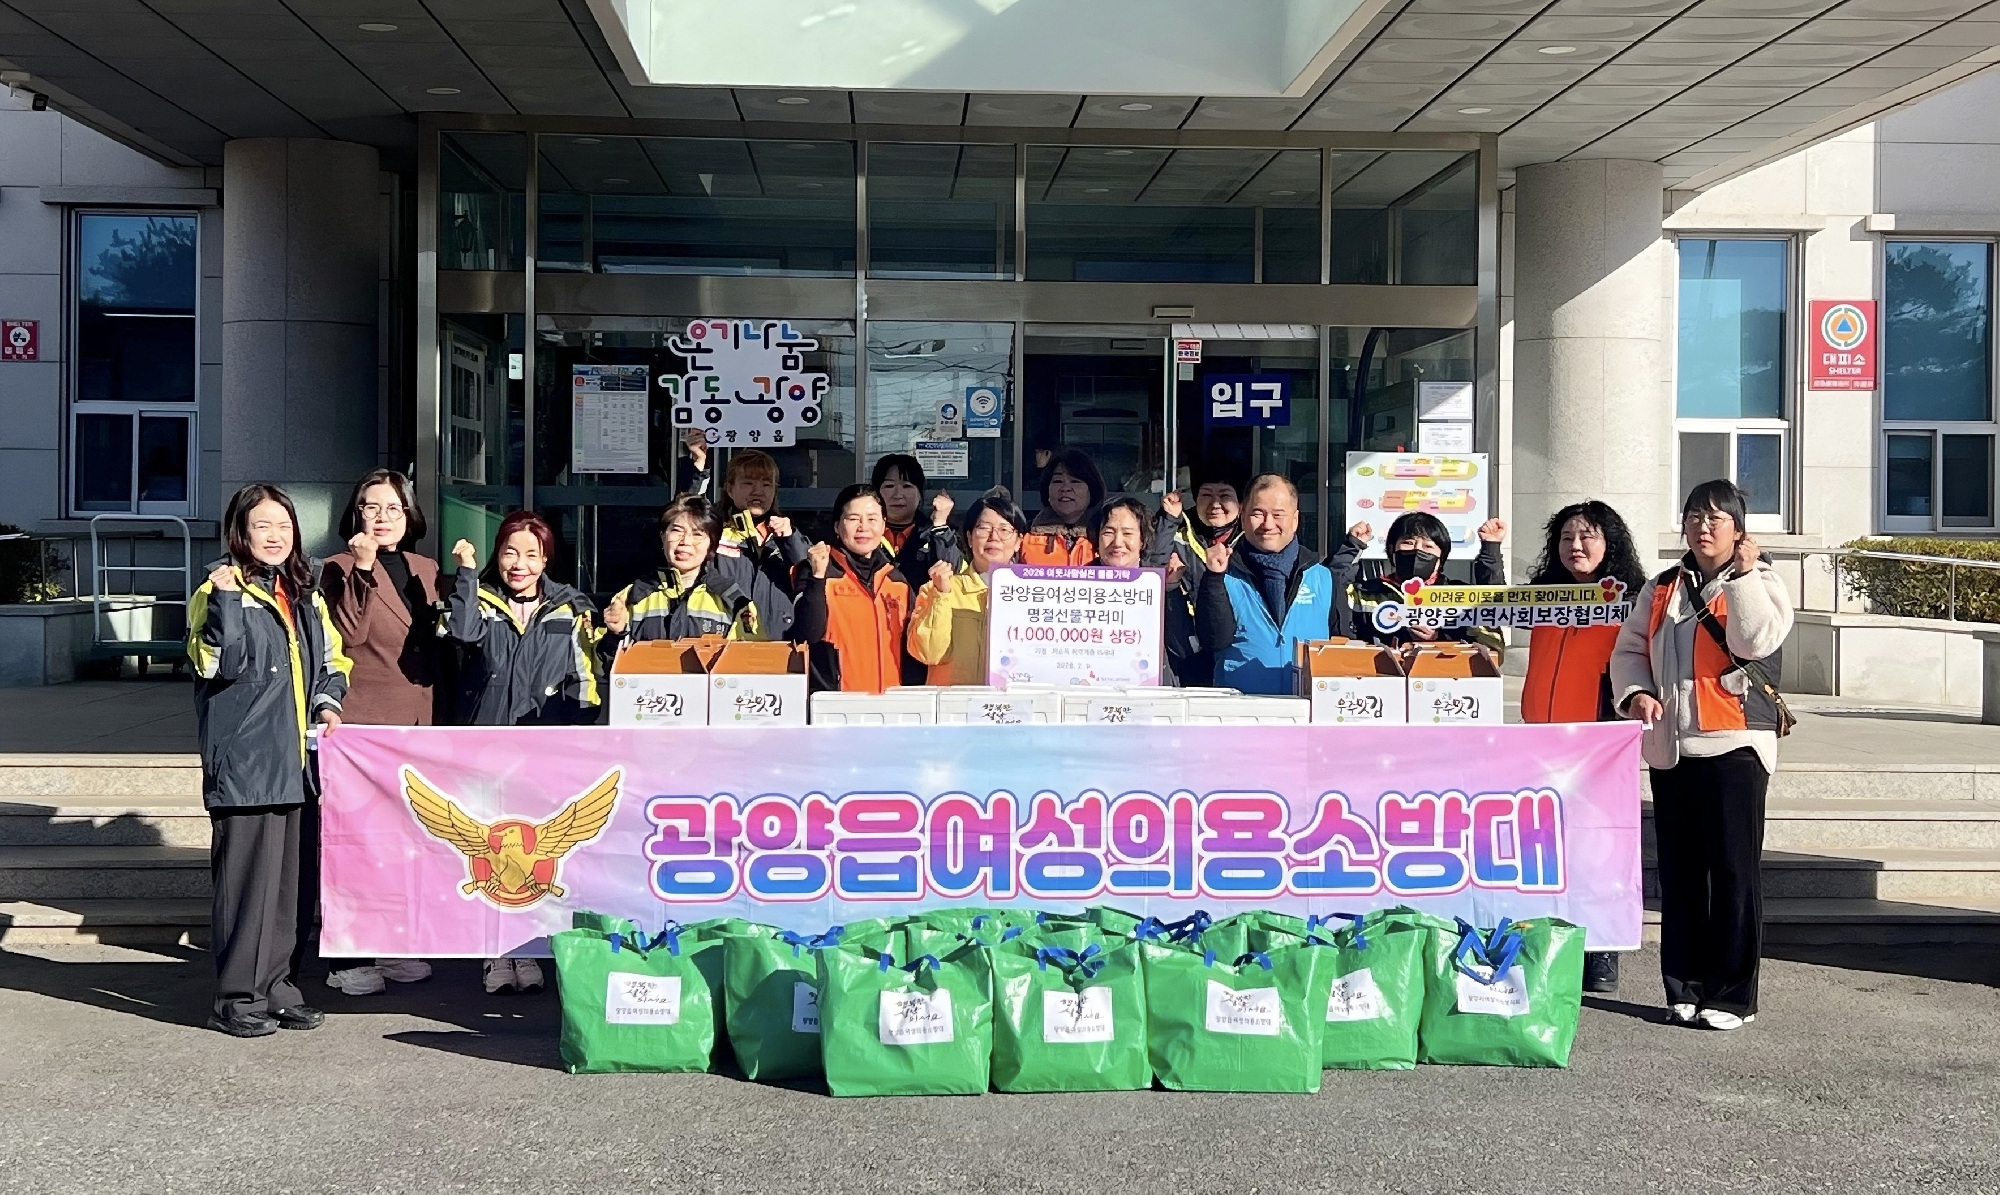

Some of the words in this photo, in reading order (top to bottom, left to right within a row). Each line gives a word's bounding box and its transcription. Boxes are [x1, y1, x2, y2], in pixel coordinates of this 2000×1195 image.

[671, 323, 816, 371] 온기나눔
[1823, 353, 1866, 365] 대피소
[1828, 367, 1862, 375] SHELTER
[1211, 382, 1283, 418] 입구
[1022, 568, 1045, 577] 2026
[1000, 585, 1153, 606] 광양읍여성의용소방대
[1430, 591, 1464, 604] 어려운
[1468, 590, 1504, 603] 이웃을
[1508, 590, 1531, 603] 먼저
[1534, 589, 1598, 603] 찾아갑니다.
[1027, 608, 1124, 625] 명절선물꾸러미
[1406, 604, 1629, 627] 광양읍지역사회보장협의체
[1007, 626, 1104, 644] (1,000,000원
[1109, 629, 1142, 645] 상당)
[646, 790, 1566, 900] 광양읍여성의용소방대
